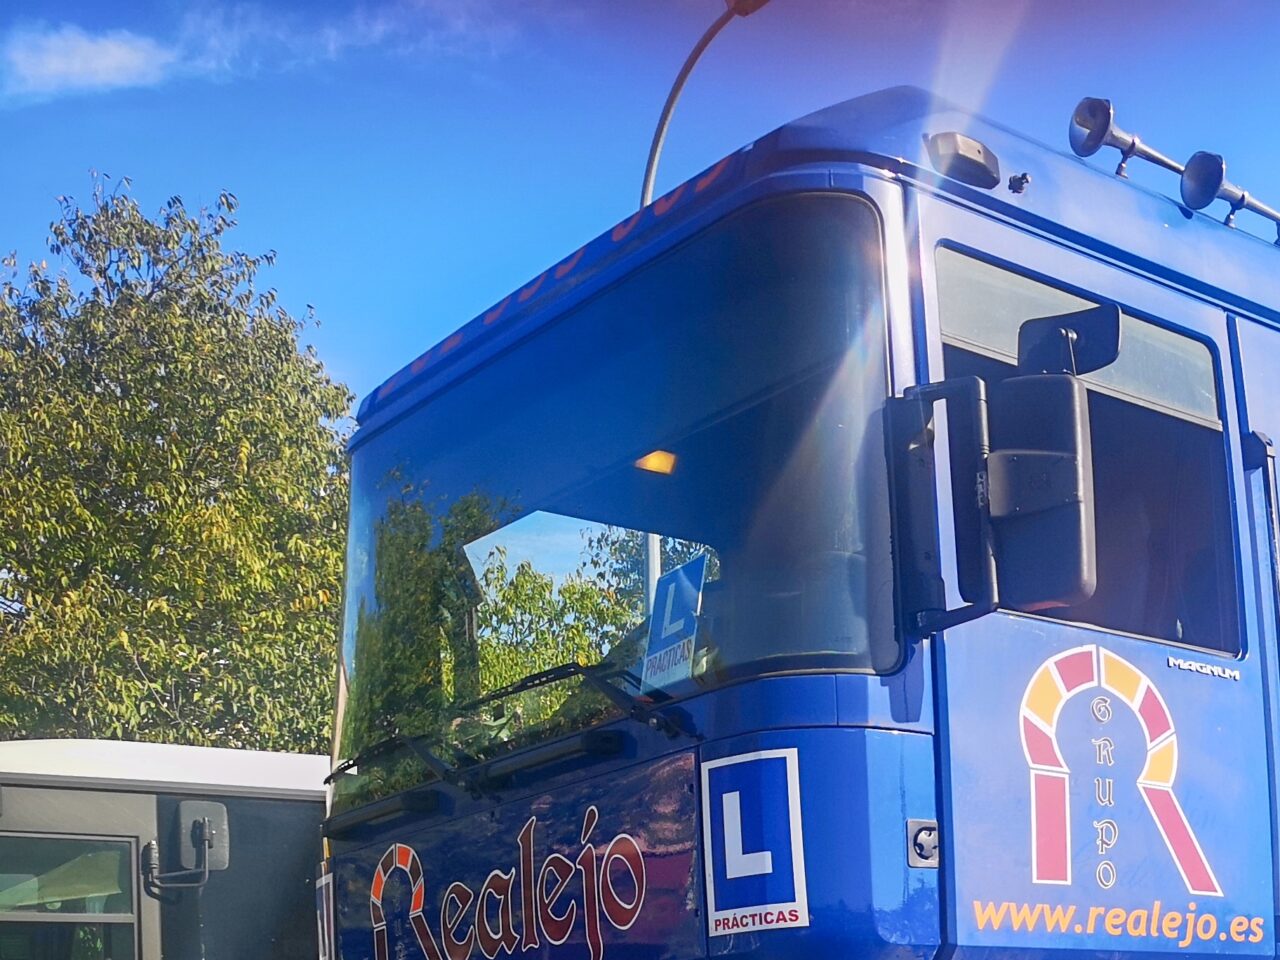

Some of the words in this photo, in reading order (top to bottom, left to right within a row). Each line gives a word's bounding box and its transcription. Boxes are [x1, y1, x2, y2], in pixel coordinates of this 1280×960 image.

[660, 582, 685, 639] L
[1167, 656, 1240, 681] MAGNUM
[722, 791, 773, 880] L
[714, 909, 799, 932] PRÁCTICAS
[973, 900, 1264, 948] www.realejo.es
